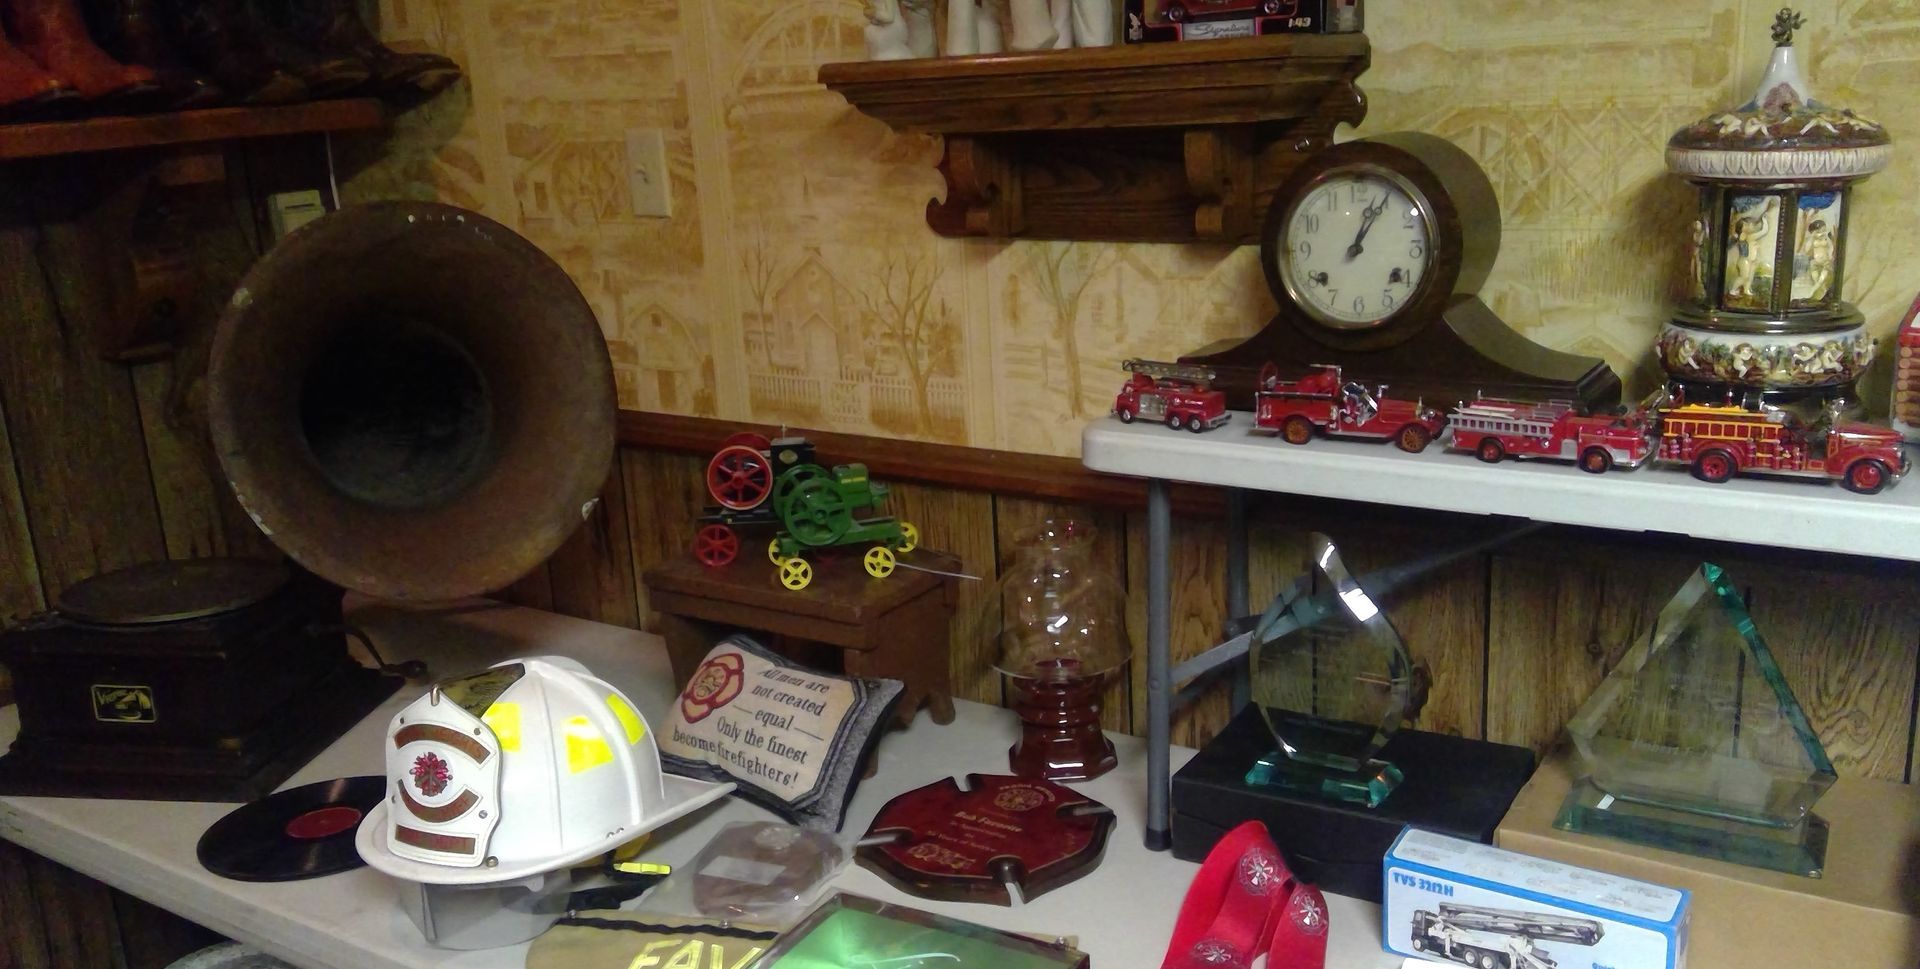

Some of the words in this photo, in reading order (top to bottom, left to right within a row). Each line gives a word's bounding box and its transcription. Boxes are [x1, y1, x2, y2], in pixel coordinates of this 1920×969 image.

[1328, 191, 1338, 211] 11
[1351, 183, 1368, 203] 12
[1304, 214, 1320, 234] 10
[1300, 240, 1312, 261] 9
[1409, 239, 1423, 259] 3
[1308, 269, 1319, 288] 8
[1401, 269, 1413, 288] 4
[1328, 289, 1339, 306] 7
[1353, 296, 1365, 315] 6
[1382, 289, 1394, 308] 5
[759, 668, 779, 681] All
[777, 672, 804, 687] men
[805, 679, 830, 694] are
[752, 684, 774, 699] not
[773, 689, 827, 717] created
[755, 709, 795, 731] equal
[717, 716, 742, 742] Only
[744, 728, 765, 748] the
[767, 735, 808, 765] finest
[673, 725, 716, 754] become
[717, 740, 800, 789] firefighters!
[1394, 872, 1417, 888] TVS
